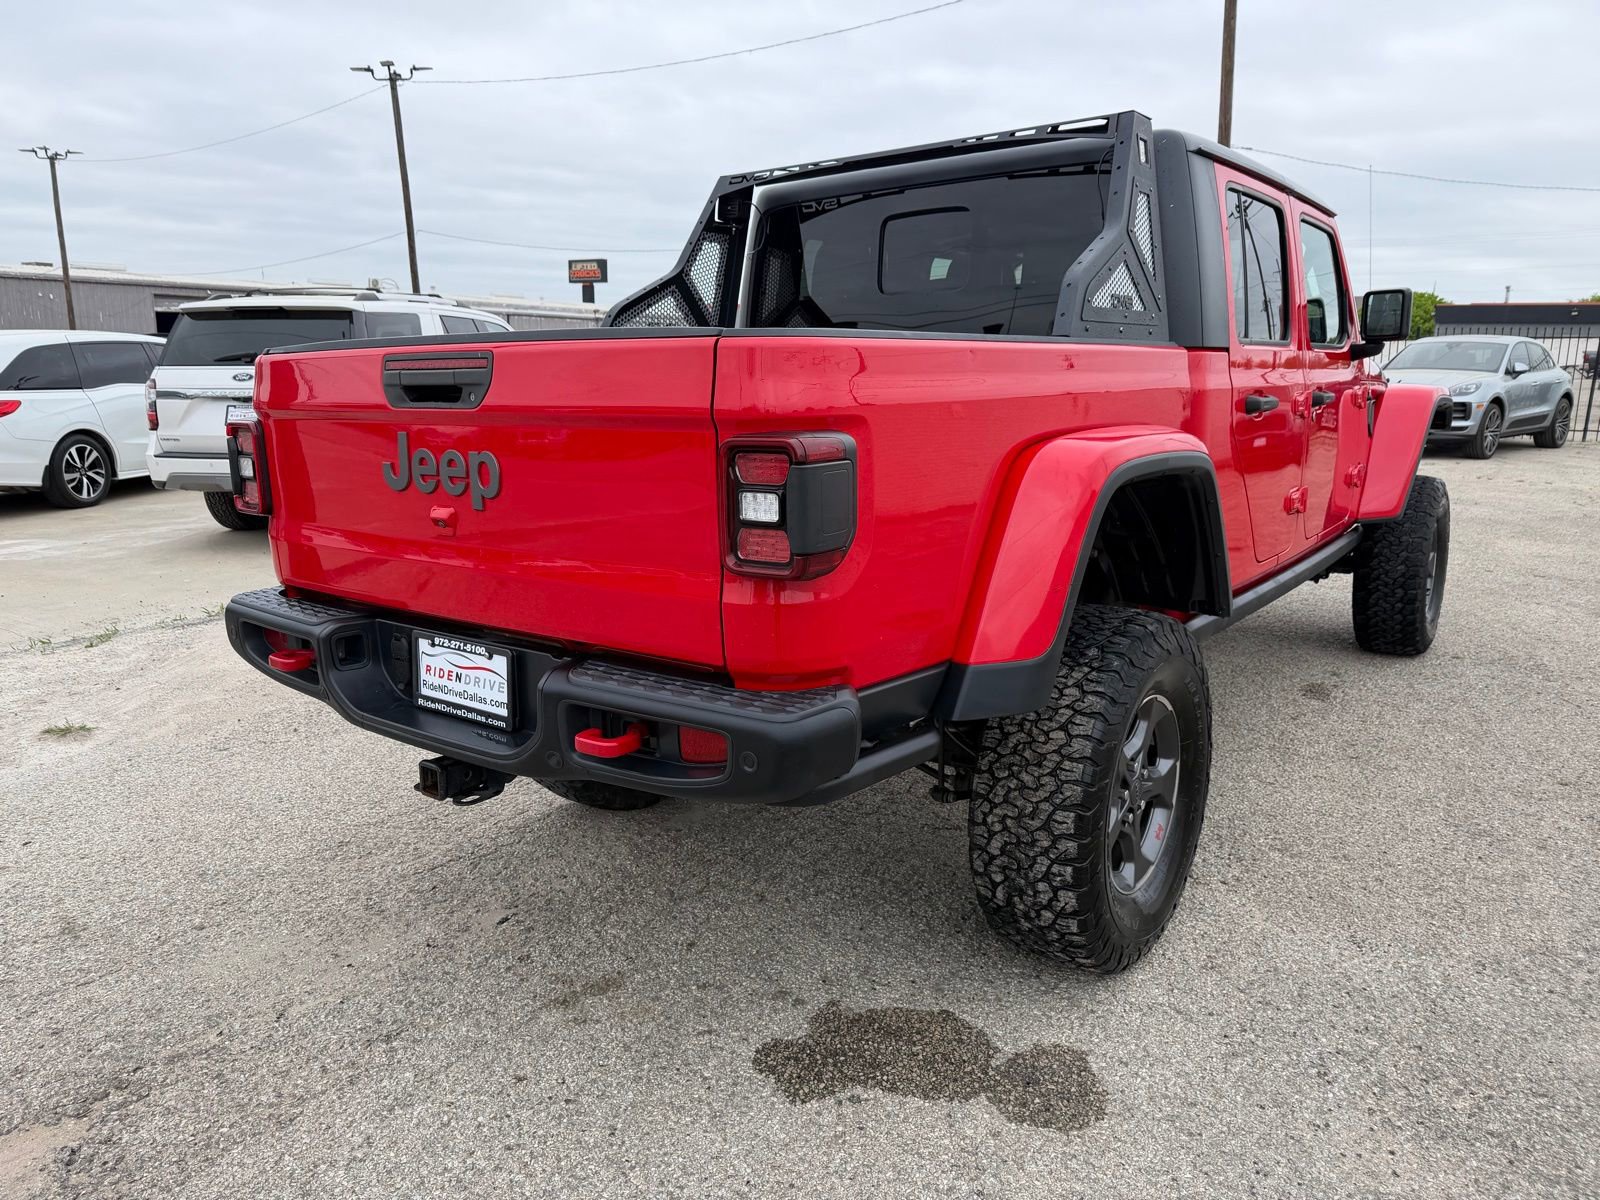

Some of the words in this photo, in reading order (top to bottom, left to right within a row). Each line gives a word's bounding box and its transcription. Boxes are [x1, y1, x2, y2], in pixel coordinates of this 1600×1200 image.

[382, 431, 500, 511] Jeep
[434, 637, 486, 655] 972-271-5100
[425, 664, 506, 694] RIDENDRIVE
[422, 679, 507, 710] RideNDriveDallas.com
[418, 698, 506, 728] RideNDriveDallas.com
